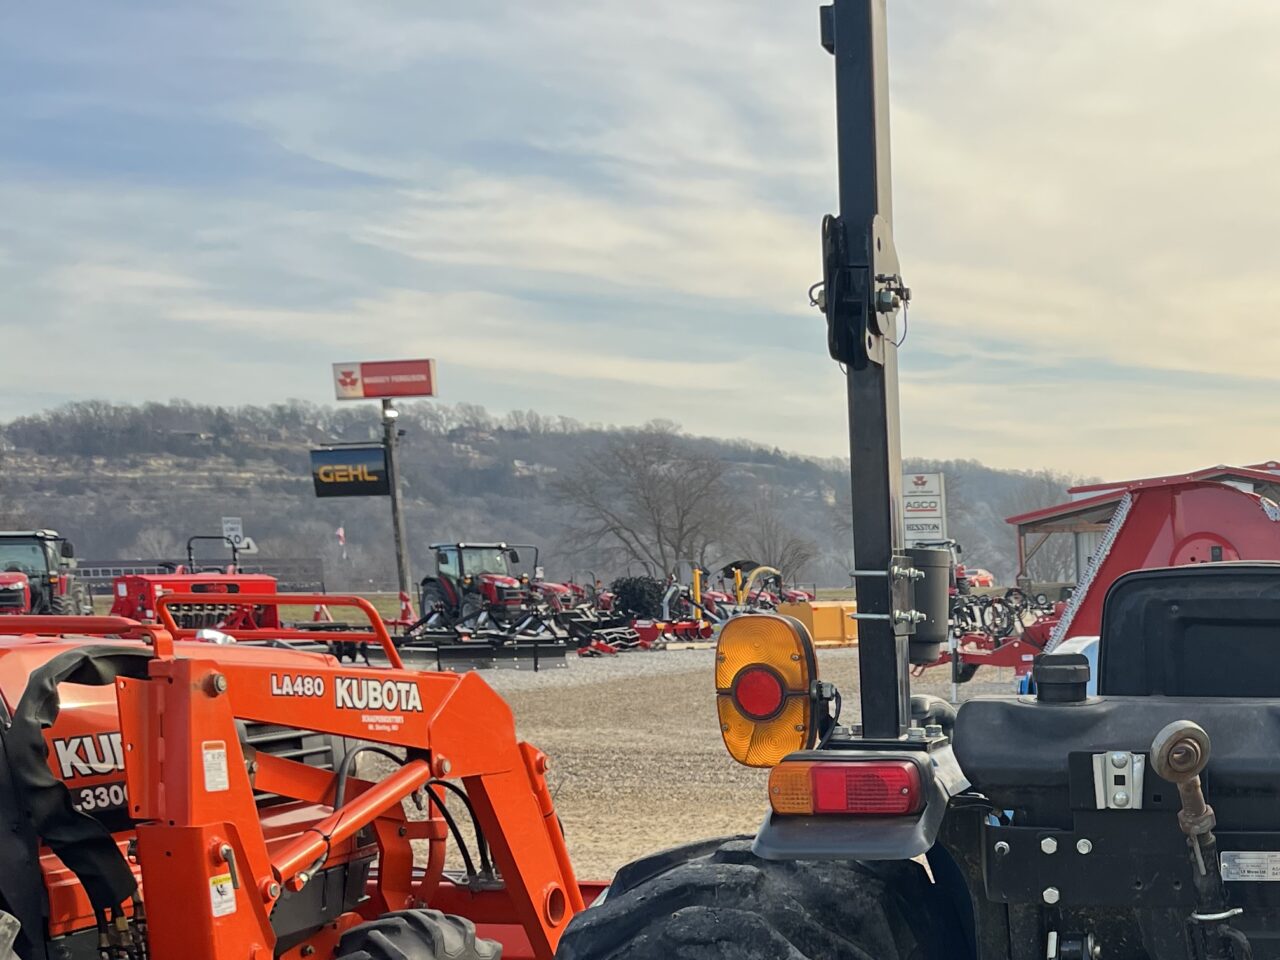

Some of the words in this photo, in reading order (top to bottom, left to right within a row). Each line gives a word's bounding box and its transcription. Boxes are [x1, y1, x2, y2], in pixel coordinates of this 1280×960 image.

[318, 464, 378, 483] GEHL
[906, 501, 937, 509] AGCO
[906, 523, 939, 531] HESSTON
[271, 673, 325, 696] LA480
[335, 676, 423, 712] KUBOTA
